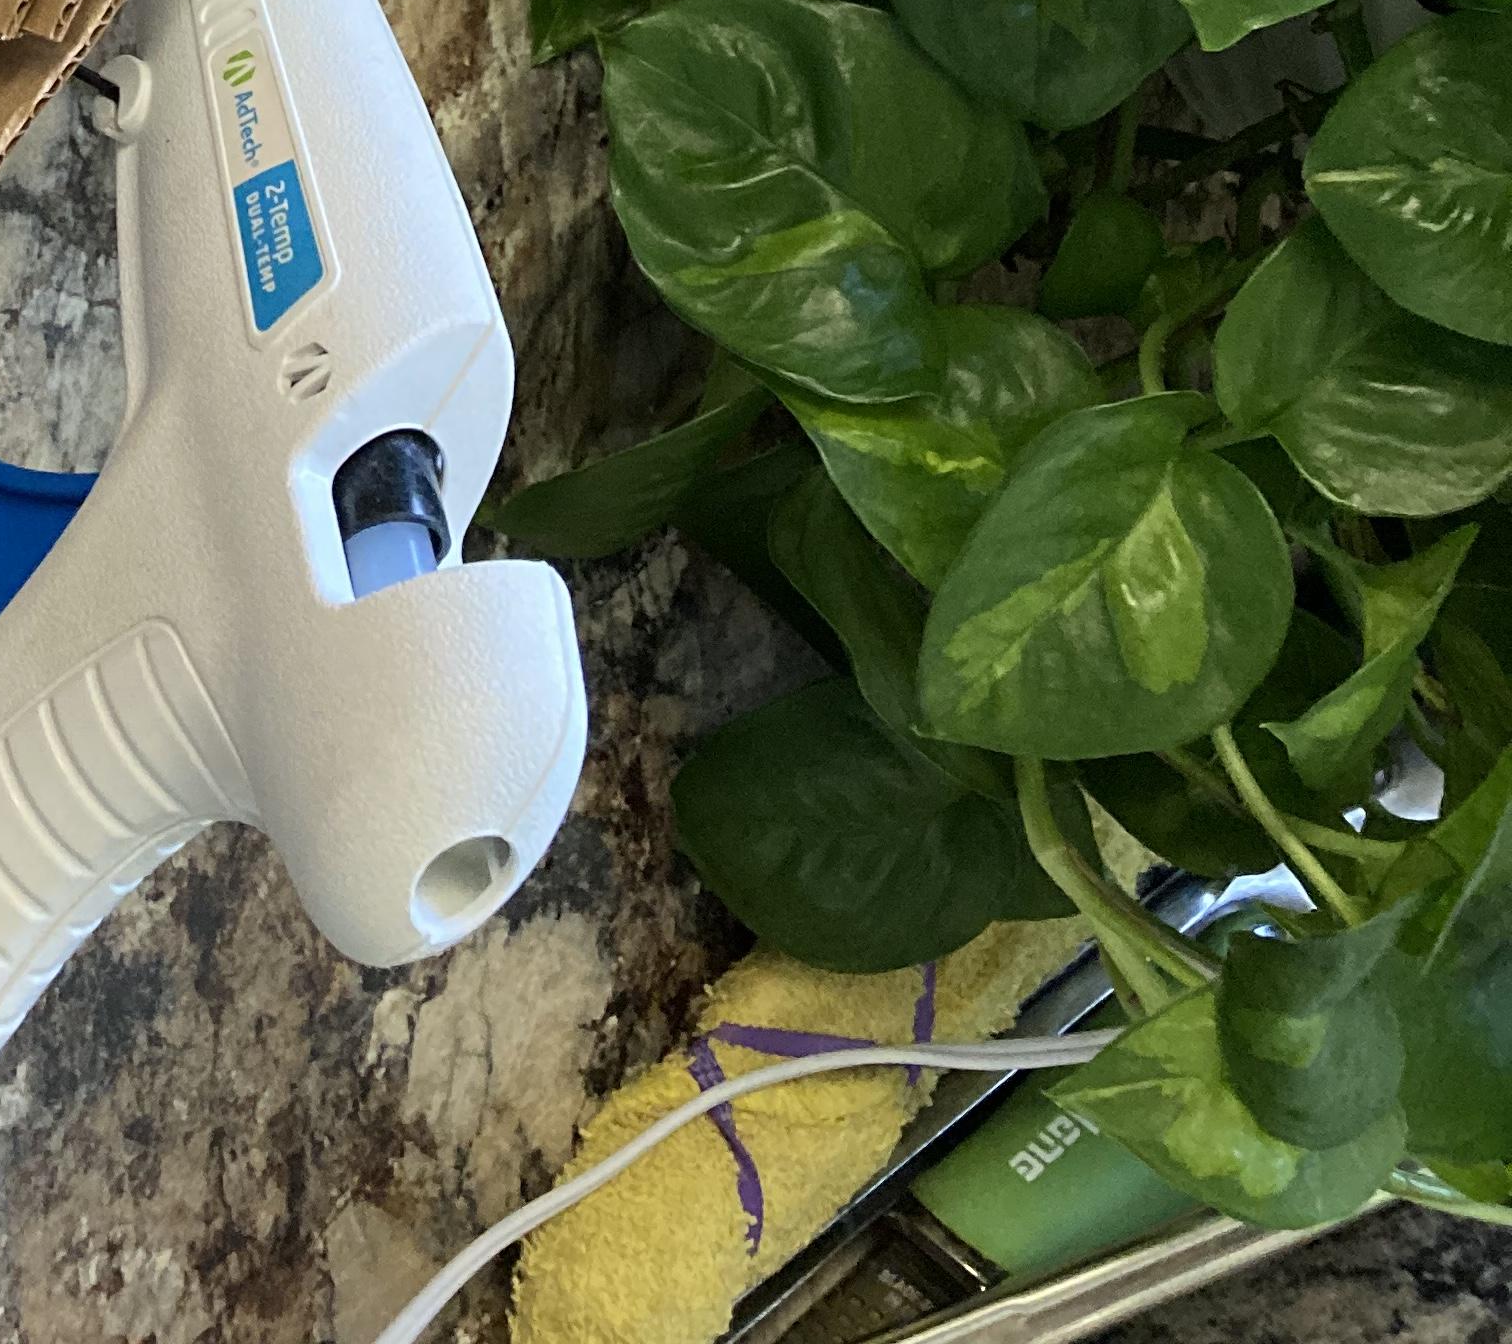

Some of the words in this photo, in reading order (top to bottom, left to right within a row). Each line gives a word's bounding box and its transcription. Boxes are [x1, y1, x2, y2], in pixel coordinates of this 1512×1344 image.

[235, 91, 262, 162] AdTech
[246, 191, 276, 293] DUAL-TEMP
[265, 180, 293, 264] 2-Temp
